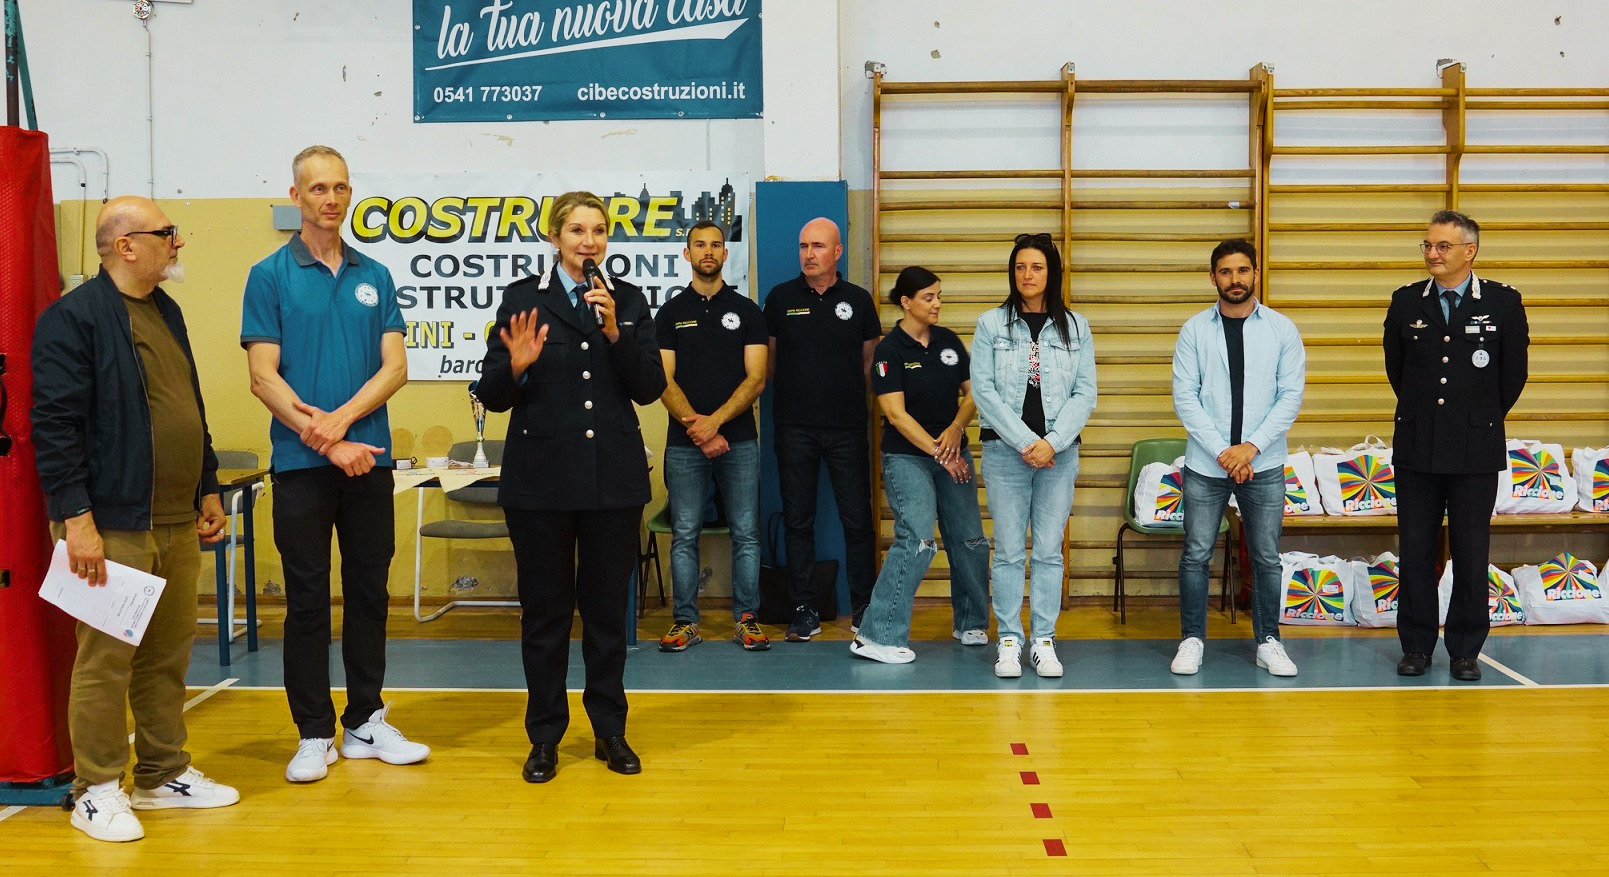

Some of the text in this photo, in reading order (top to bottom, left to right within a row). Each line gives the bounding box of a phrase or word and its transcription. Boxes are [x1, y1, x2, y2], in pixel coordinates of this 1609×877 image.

[437, 5, 474, 59] la
[480, 0, 545, 52] tua
[551, 0, 659, 42] nuova
[433, 85, 542, 103] 0541 773037
[577, 81, 746, 101] cibecostruzioni.it
[1513, 484, 1563, 500] Riccione
[1547, 586, 1601, 600] Riccione
[1286, 608, 1344, 621] Riccione
